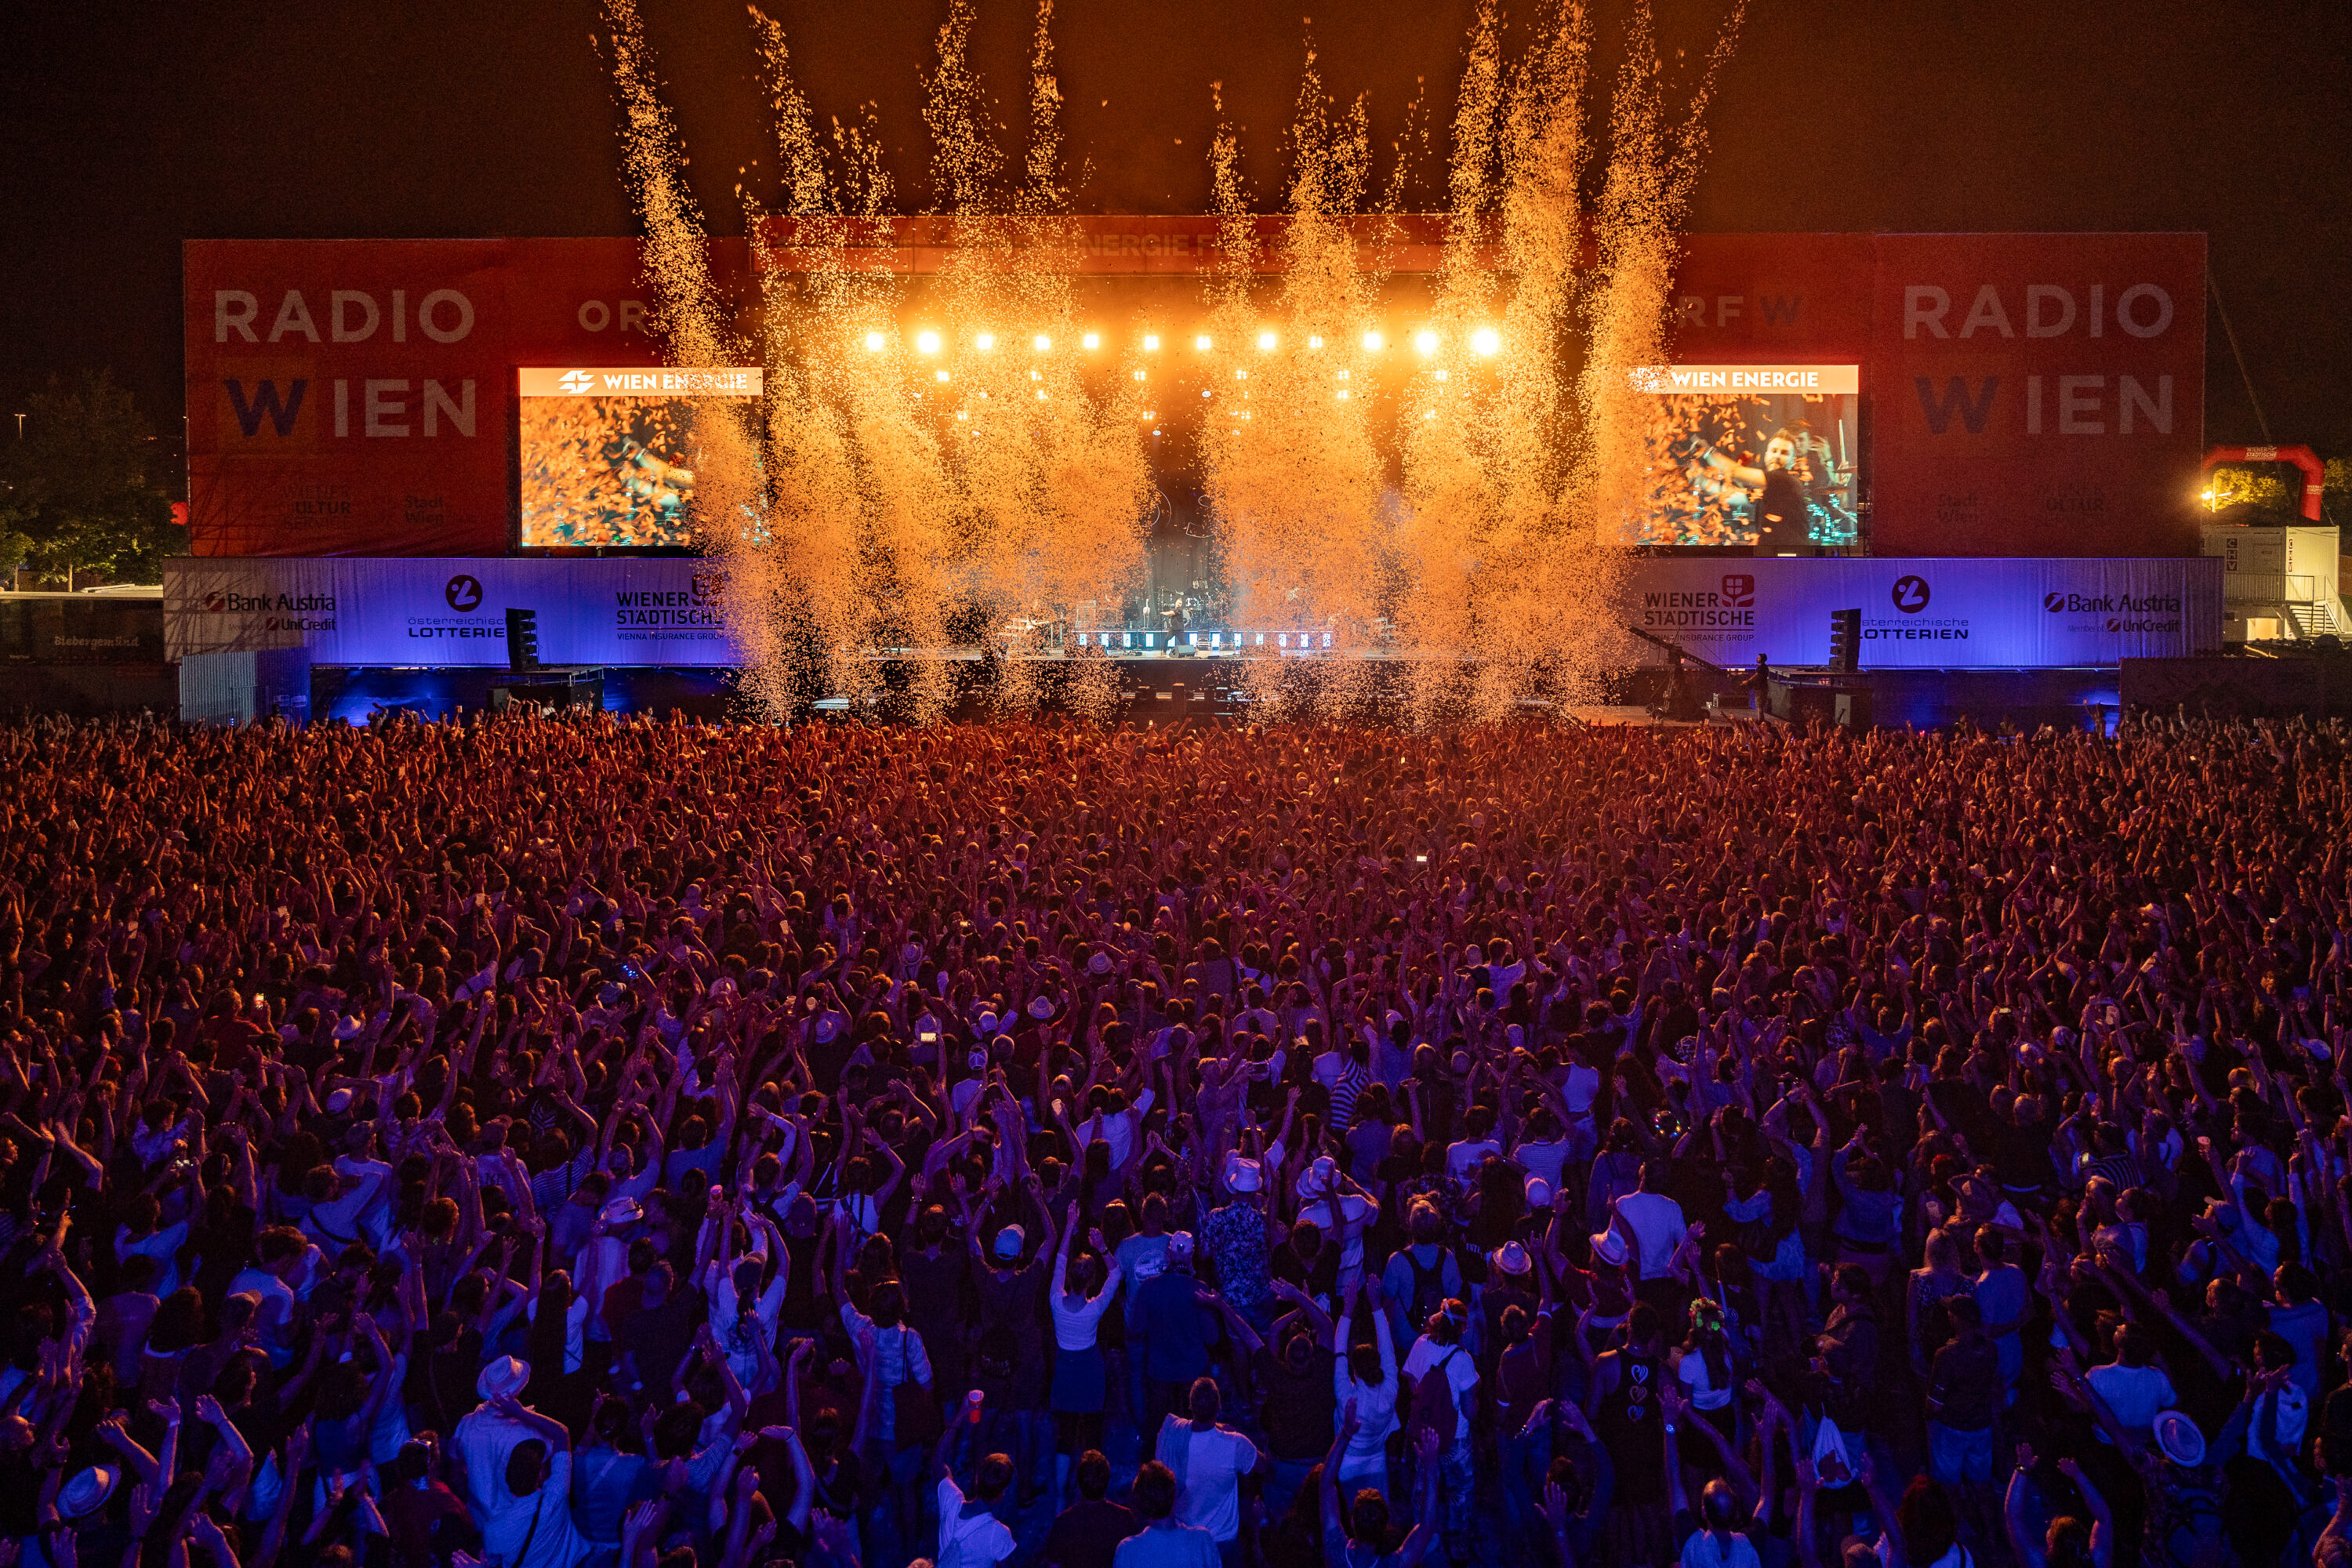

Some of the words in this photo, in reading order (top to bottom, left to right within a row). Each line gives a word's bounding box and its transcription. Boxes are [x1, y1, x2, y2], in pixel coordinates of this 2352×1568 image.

[216, 289, 475, 343] RADIO
[578, 299, 671, 332] OR
[1679, 296, 1744, 328] RF
[1904, 282, 2175, 339] RADIO
[603, 374, 657, 390] WIEN
[1671, 372, 1726, 387] WIEN
[1732, 372, 1819, 387] ENERGIE
[228, 593, 272, 612] Bank
[277, 593, 336, 612] Austria
[616, 592, 689, 607] WIENER
[1644, 592, 1719, 608] WIENER
[2067, 593, 2114, 612] Bank
[2118, 593, 2181, 612] Austria
[281, 618, 336, 631] UniCredit
[408, 616, 506, 626] österreichisc
[616, 609, 724, 625] STÄDTISCHE
[1644, 610, 1755, 626] STÄDTISCHE
[1862, 617, 1969, 626] sterreichische
[408, 627, 506, 638] LOTTERIE
[2122, 618, 2180, 633] UniCredit
[1860, 629, 1969, 640] OTTERIEN
